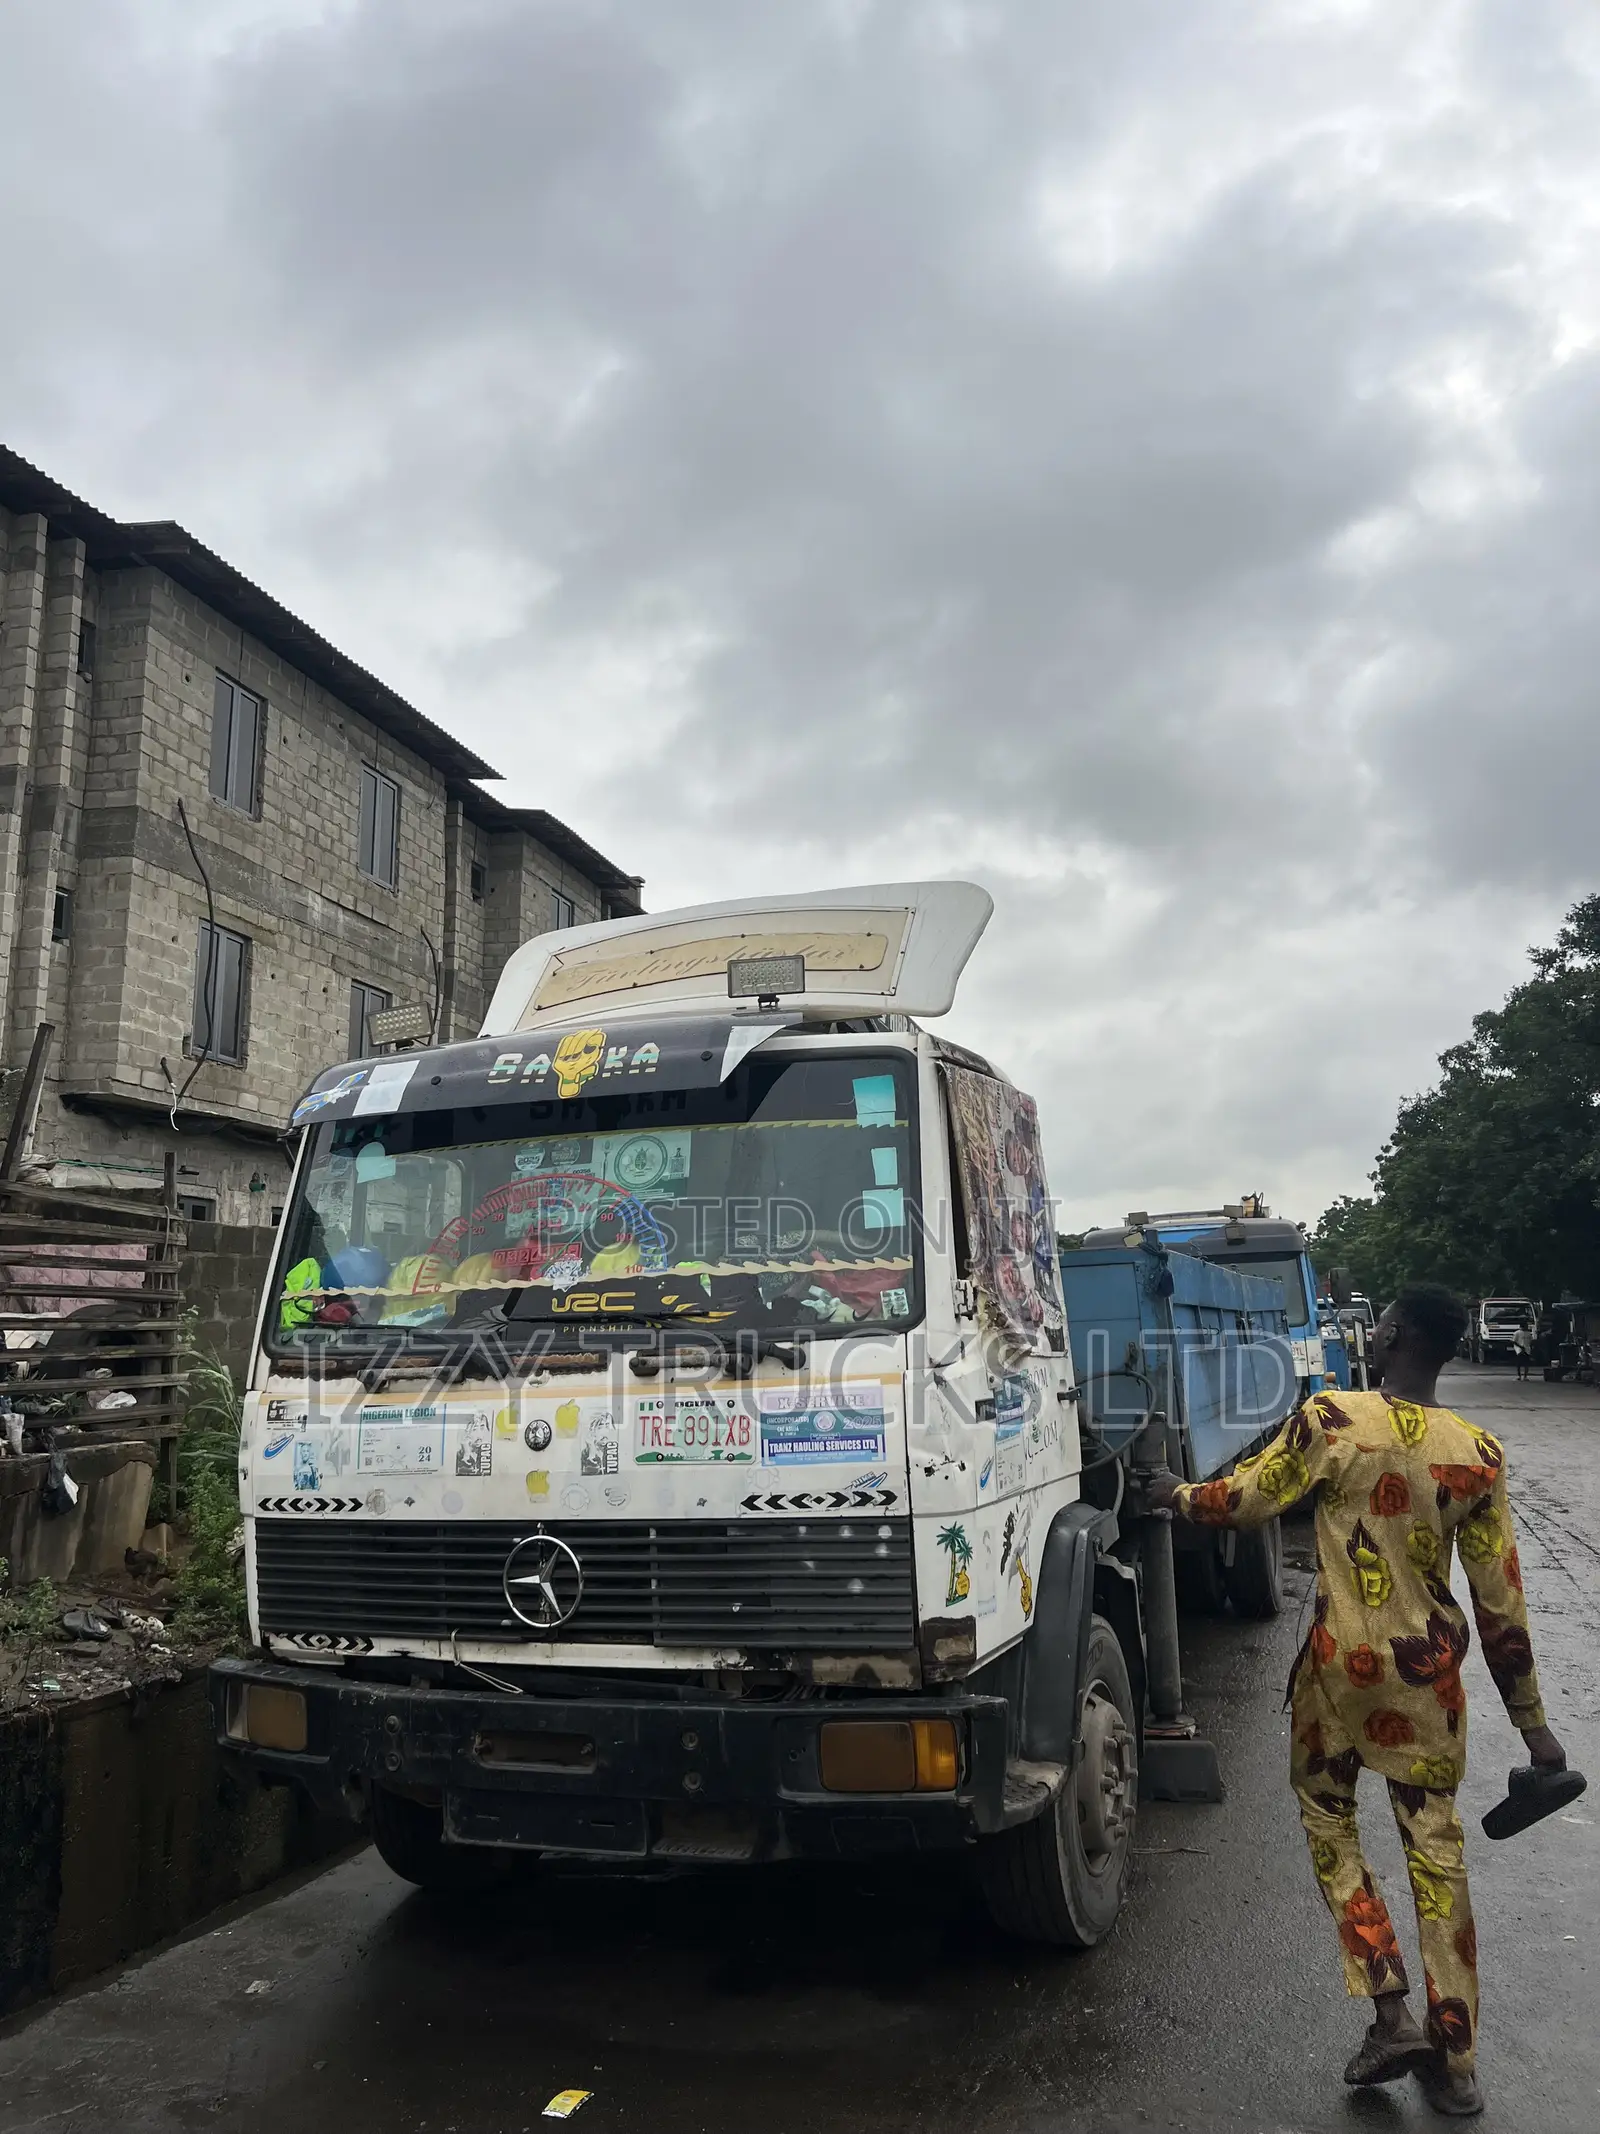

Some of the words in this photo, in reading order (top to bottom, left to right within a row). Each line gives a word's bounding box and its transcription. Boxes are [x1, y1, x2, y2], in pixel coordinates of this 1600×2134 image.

[600, 1213, 614, 1222] 90
[625, 1264, 642, 1274] 110
[362, 1408, 403, 1421] NIGERIAN
[404, 1407, 437, 1419] LEGION
[842, 1415, 883, 1431] 2025
[769, 1442, 793, 1454] TRANZ
[793, 1441, 825, 1453] HAULING
[826, 1440, 861, 1451] SERVICES
[862, 1439, 878, 1450] LTD.
[481, 1442, 492, 1476] TUPAC
[606, 1441, 618, 1475] TUPAC
